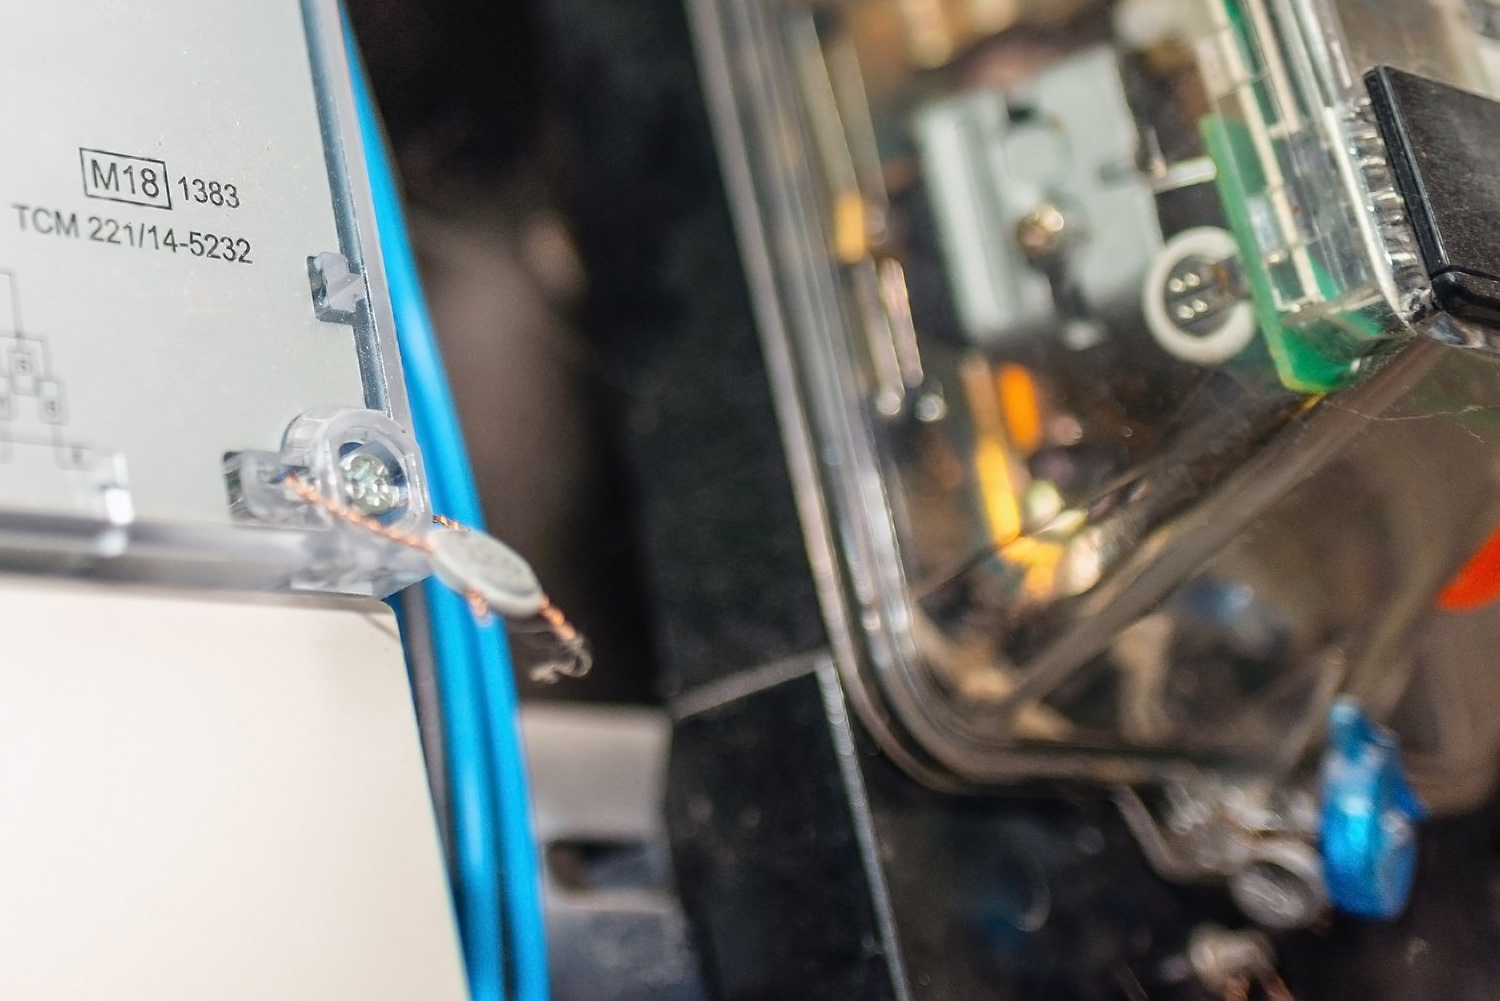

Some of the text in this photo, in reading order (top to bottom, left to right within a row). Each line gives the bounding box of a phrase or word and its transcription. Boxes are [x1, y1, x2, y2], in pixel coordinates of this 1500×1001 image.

[91, 159, 240, 209] M18 1383
[11, 202, 254, 265] TCM 221/14-5232
